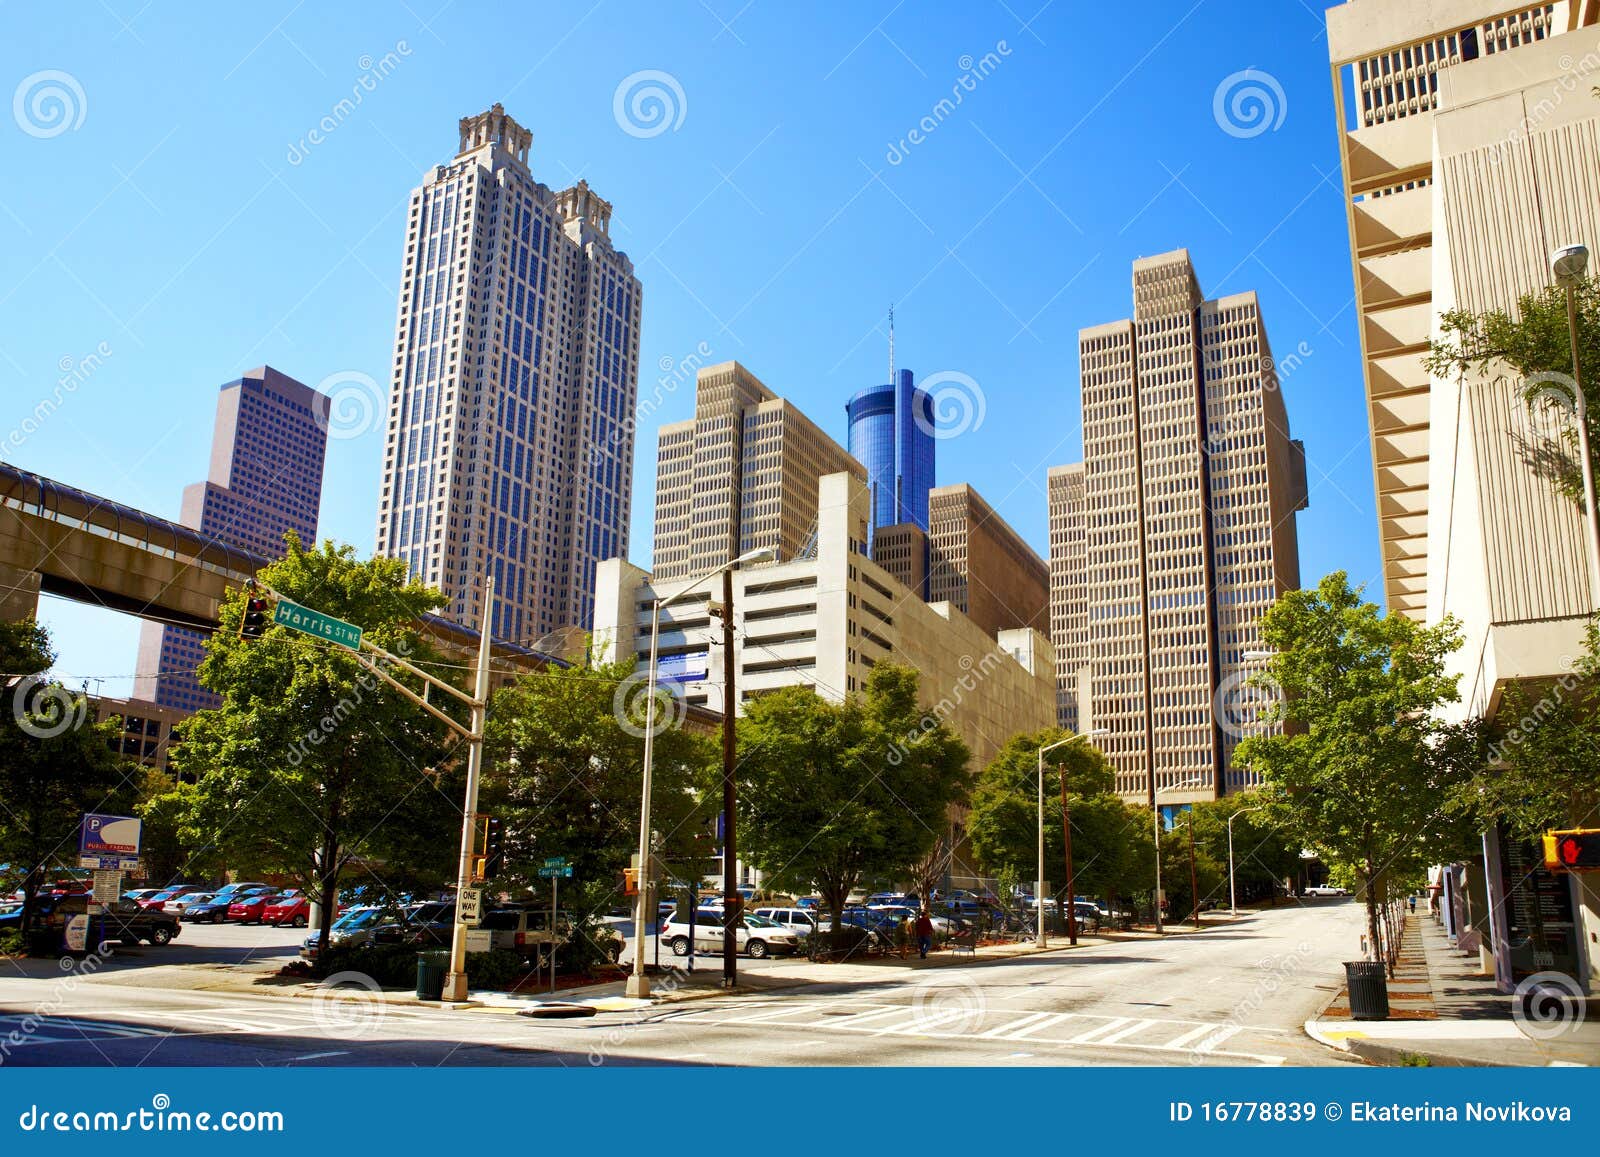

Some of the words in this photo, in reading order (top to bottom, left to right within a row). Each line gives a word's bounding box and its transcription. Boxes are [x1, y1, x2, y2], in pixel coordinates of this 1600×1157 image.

[280, 606, 332, 635] Harris
[335, 625, 346, 638] ST
[347, 632, 359, 643] NE
[91, 819, 100, 829] P
[463, 891, 477, 900] ONE
[462, 902, 477, 911] WAY
